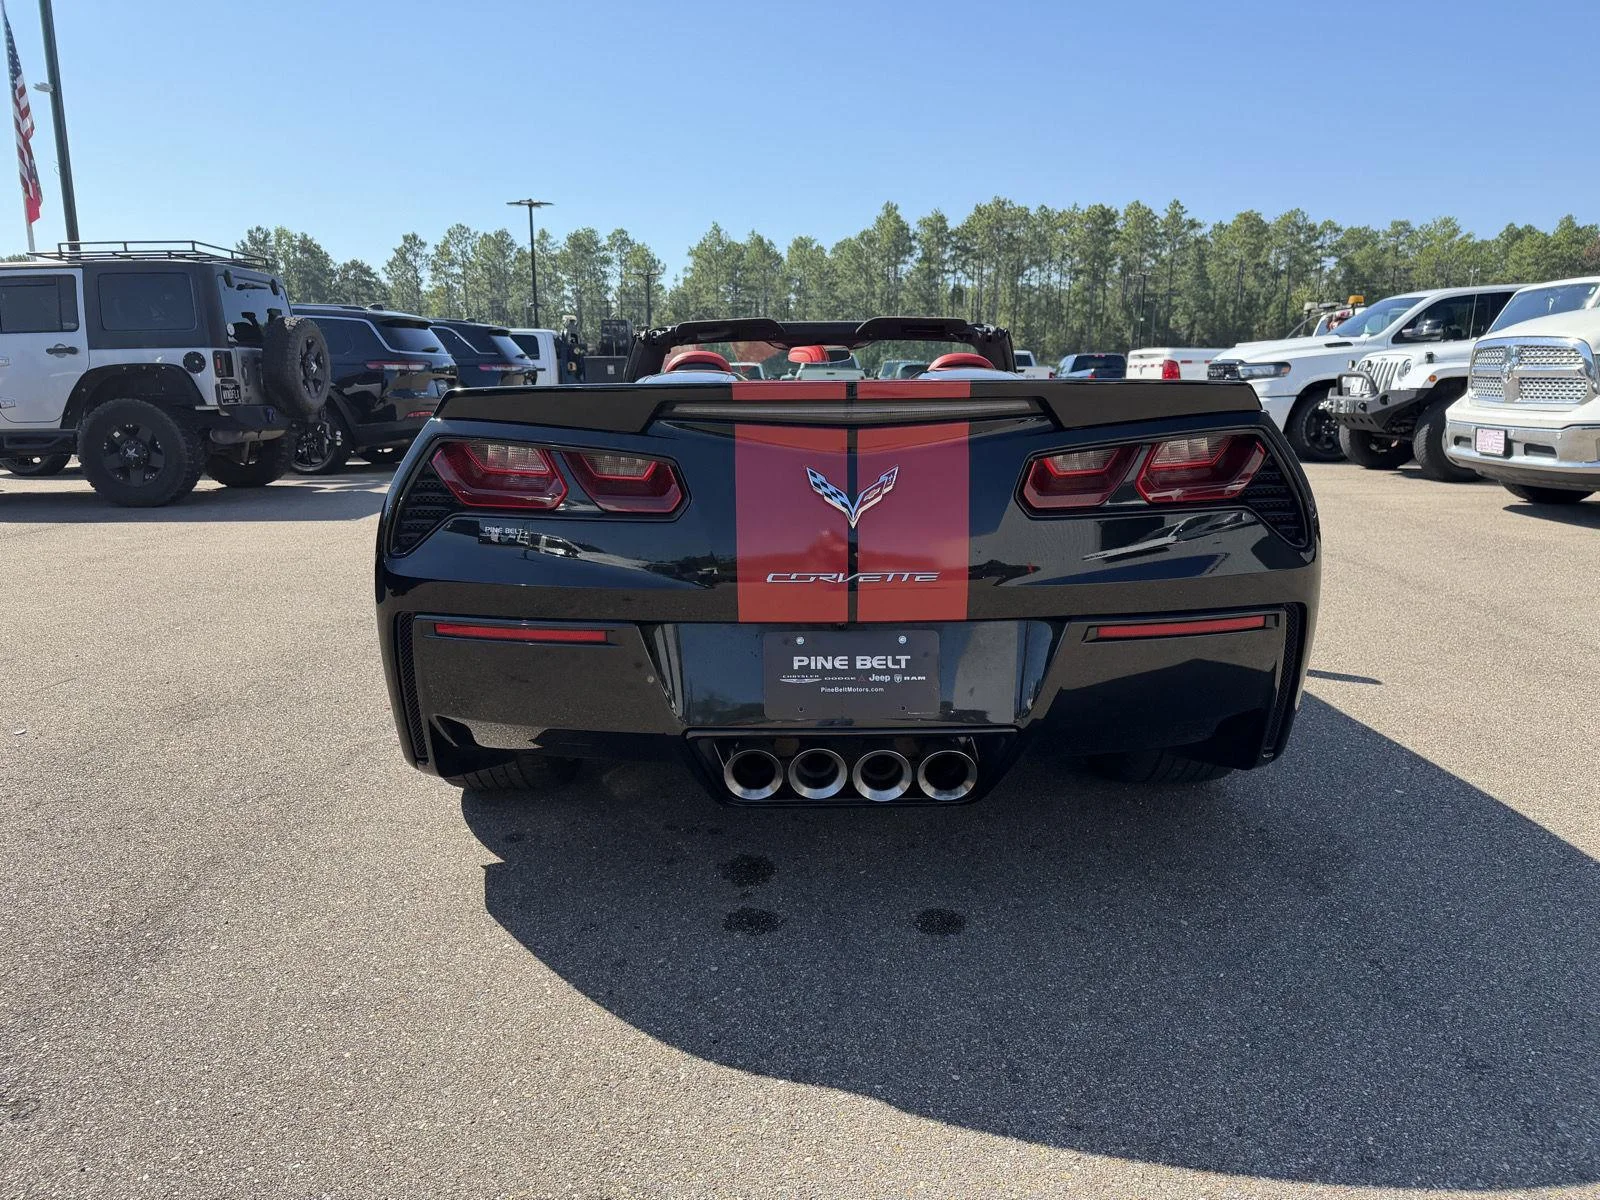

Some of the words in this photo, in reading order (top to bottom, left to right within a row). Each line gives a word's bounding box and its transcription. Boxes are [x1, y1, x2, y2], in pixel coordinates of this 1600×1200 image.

[484, 526, 503, 534] PINE
[505, 527, 523, 535] BELT
[766, 571, 941, 584] CORVETTE
[793, 656, 849, 670] PINE
[856, 655, 911, 669] BELT
[869, 673, 891, 683] Jeep
